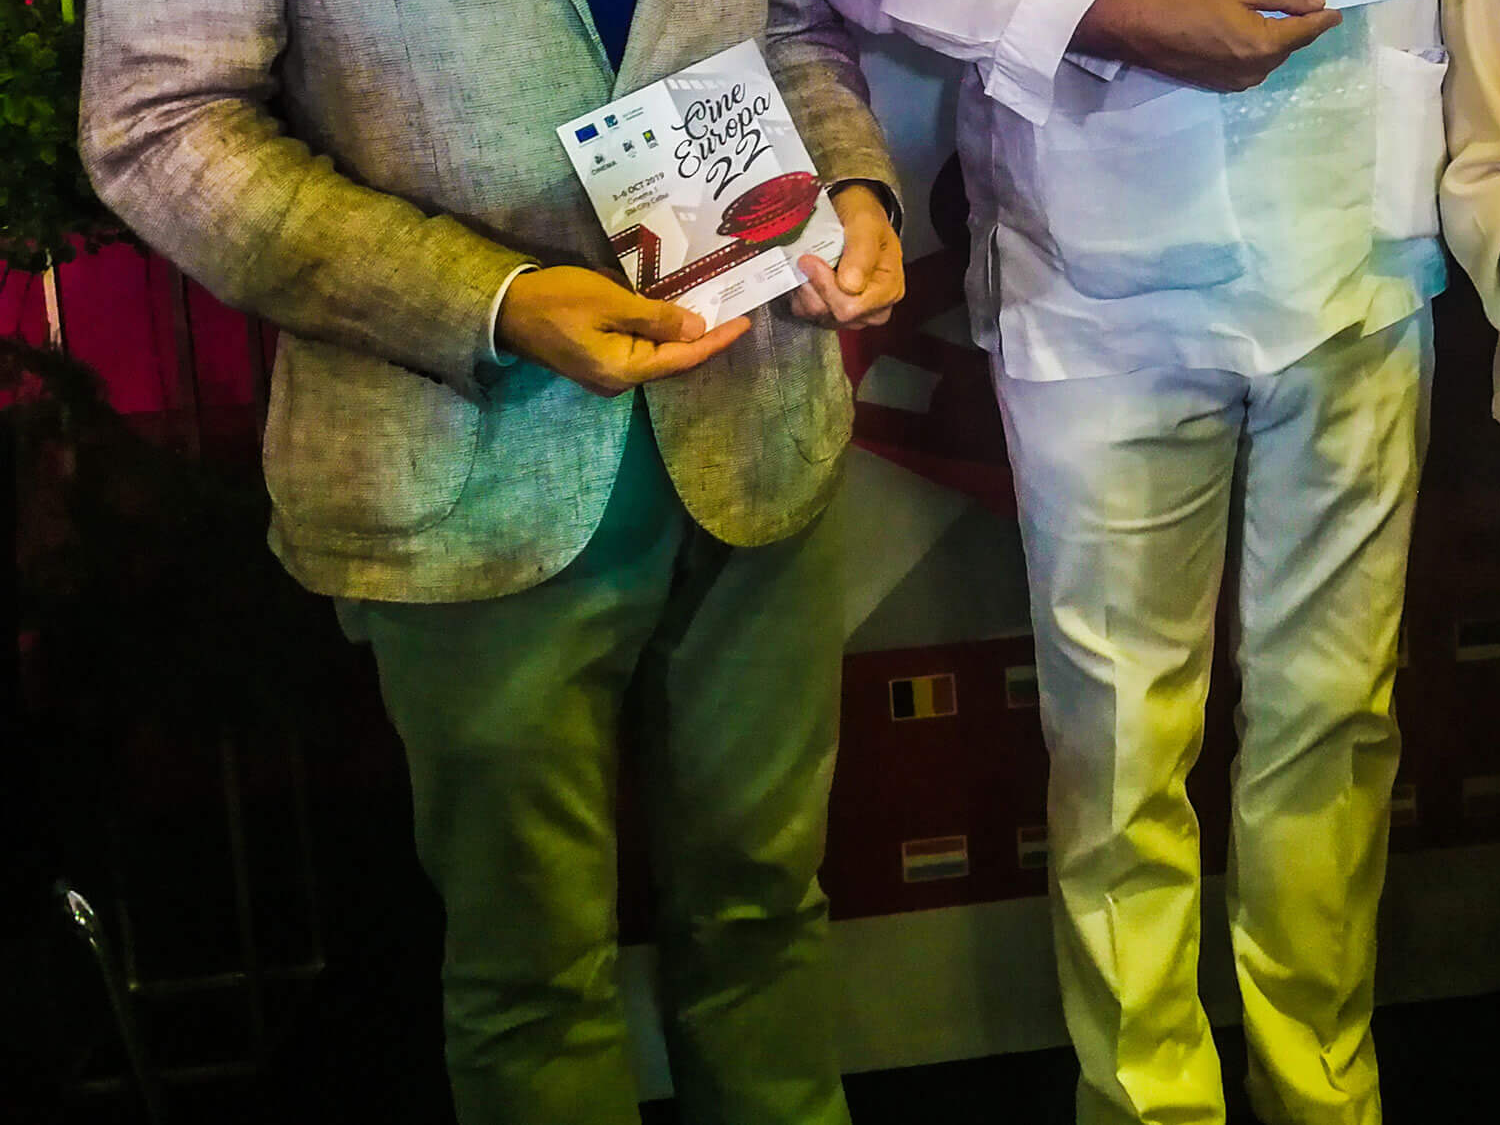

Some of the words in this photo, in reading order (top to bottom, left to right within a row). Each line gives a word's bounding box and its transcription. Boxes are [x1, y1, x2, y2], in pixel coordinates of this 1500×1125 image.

[672, 82, 746, 141] Cine
[674, 92, 770, 178] Europa
[705, 128, 774, 201] 22
